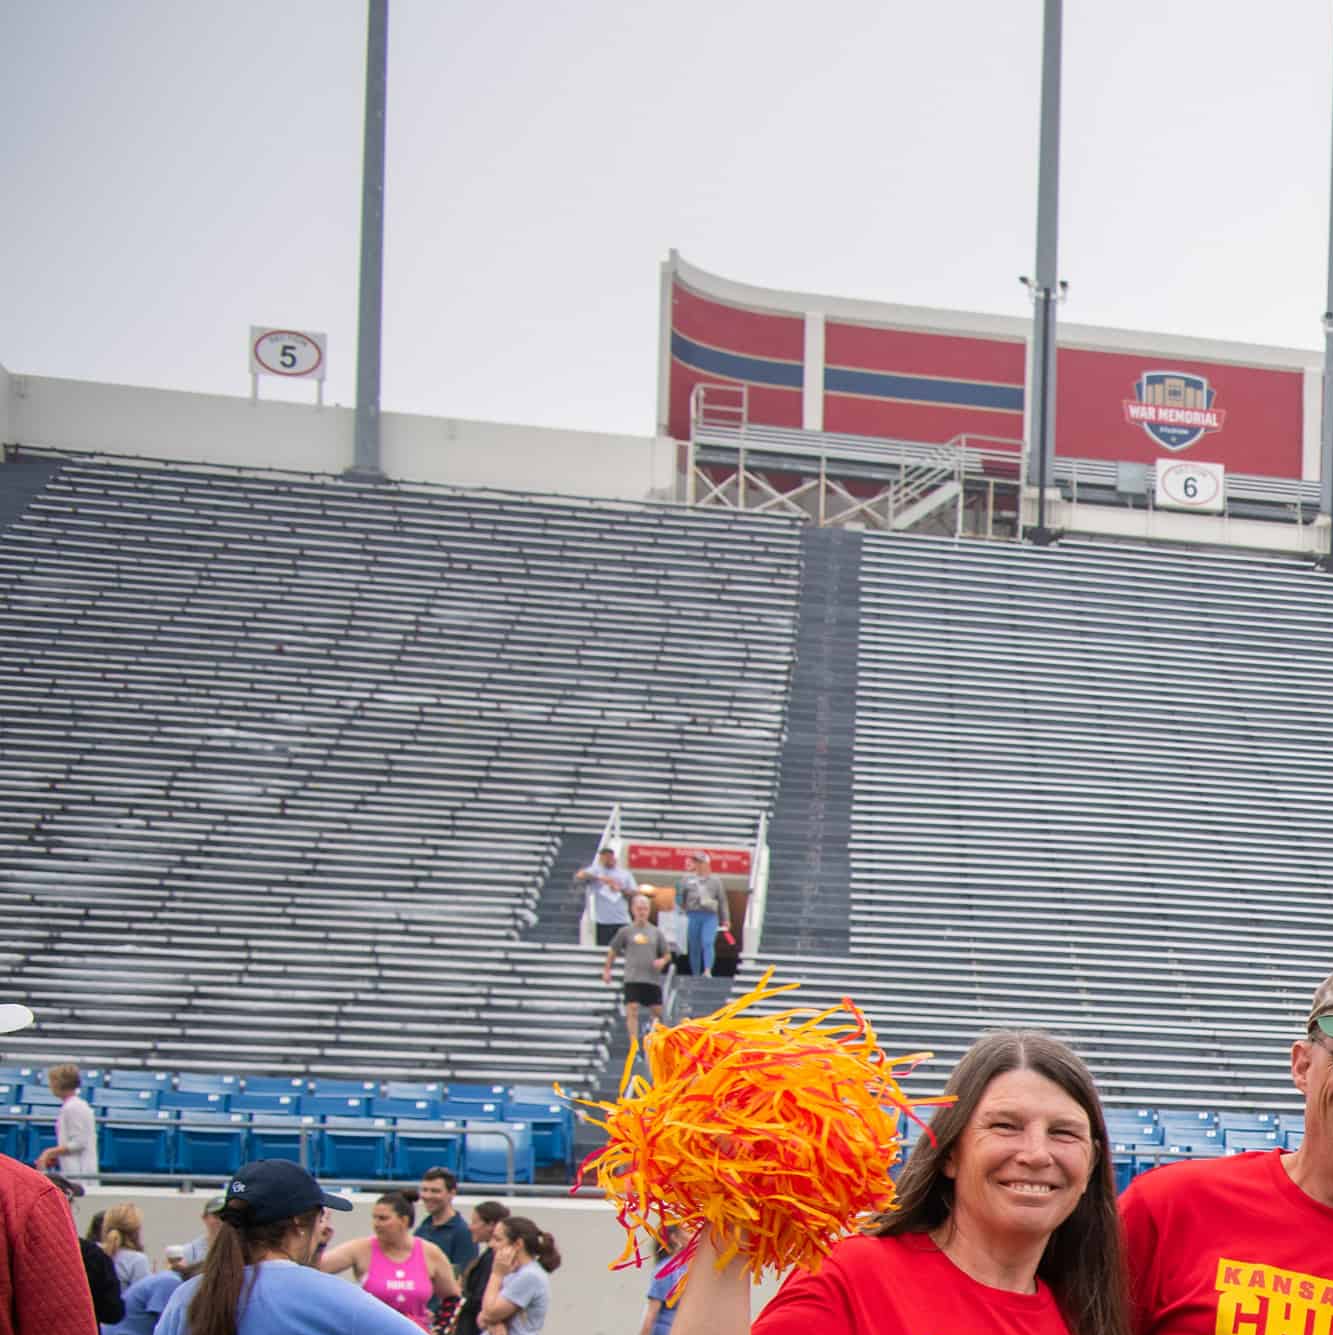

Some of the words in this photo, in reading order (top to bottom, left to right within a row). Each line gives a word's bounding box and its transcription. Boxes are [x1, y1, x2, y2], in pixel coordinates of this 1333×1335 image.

[280, 344, 297, 368] 5
[1128, 404, 1156, 420] WAR
[1157, 407, 1219, 426] MEMORIAL
[1183, 476, 1198, 498] 6
